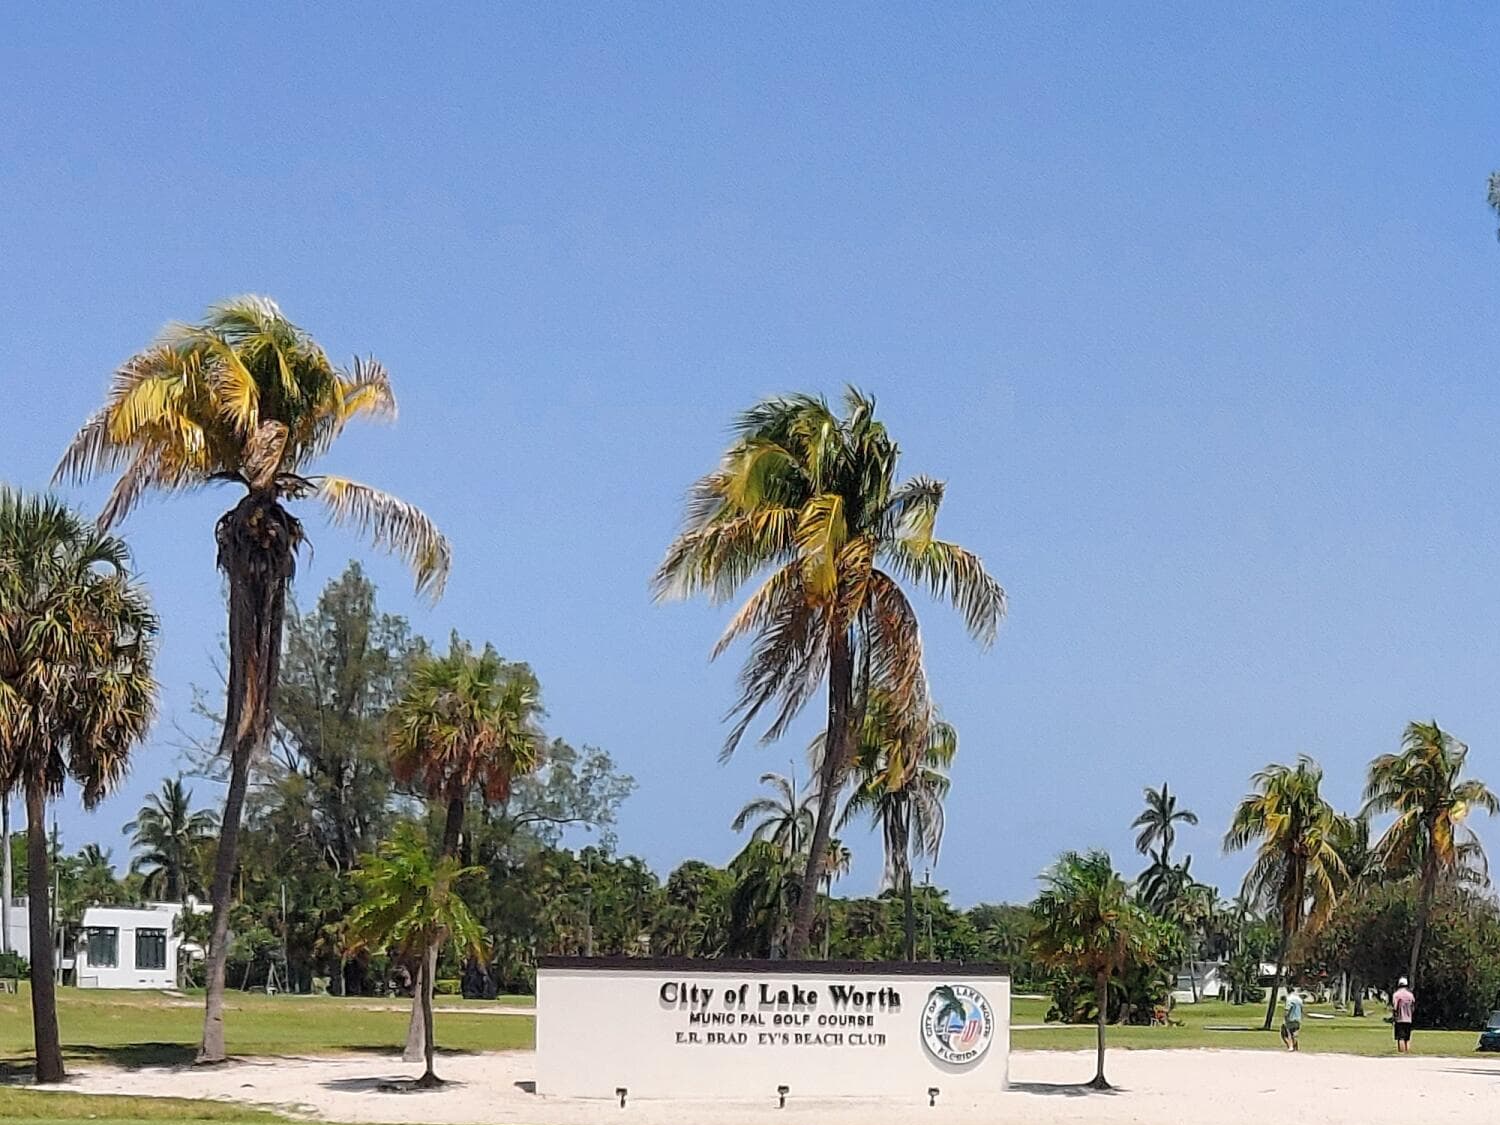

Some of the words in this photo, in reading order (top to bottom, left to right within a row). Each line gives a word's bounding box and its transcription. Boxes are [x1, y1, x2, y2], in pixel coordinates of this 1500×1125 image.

[660, 981, 714, 1007] City
[725, 983, 749, 1003] of
[759, 983, 818, 1005] Lake
[828, 985, 901, 1007] Worth
[956, 987, 981, 1002] LAKE
[774, 1013, 810, 1026] GOLF
[818, 1014, 874, 1027] COURSE
[795, 1033, 843, 1046] BEACH
[848, 1033, 886, 1047] CLUB
[938, 1047, 978, 1061] FLORIDA
